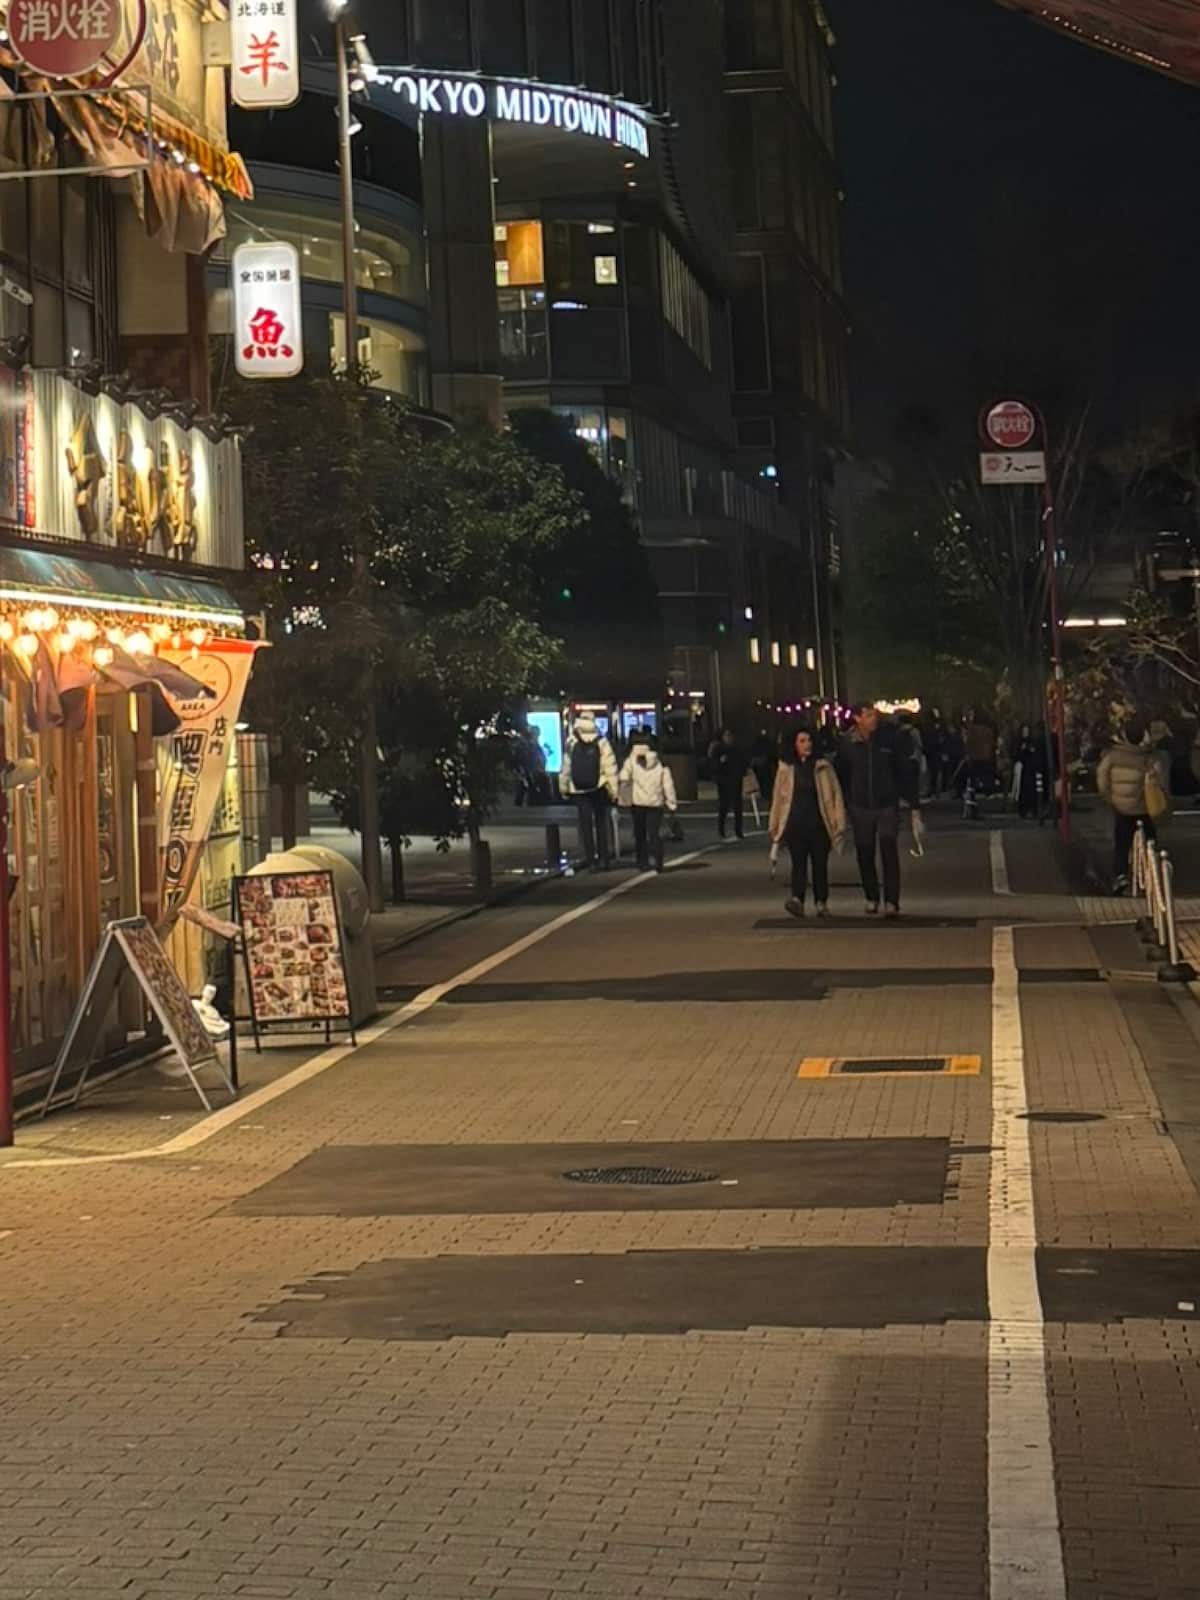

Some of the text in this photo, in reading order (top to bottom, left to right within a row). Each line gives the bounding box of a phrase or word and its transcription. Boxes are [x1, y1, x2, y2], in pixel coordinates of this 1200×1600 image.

[240, 30, 290, 88] 羊
[374, 72, 487, 117] OKYO
[496, 84, 612, 140] MIDTOWN
[243, 307, 294, 360] 魚
